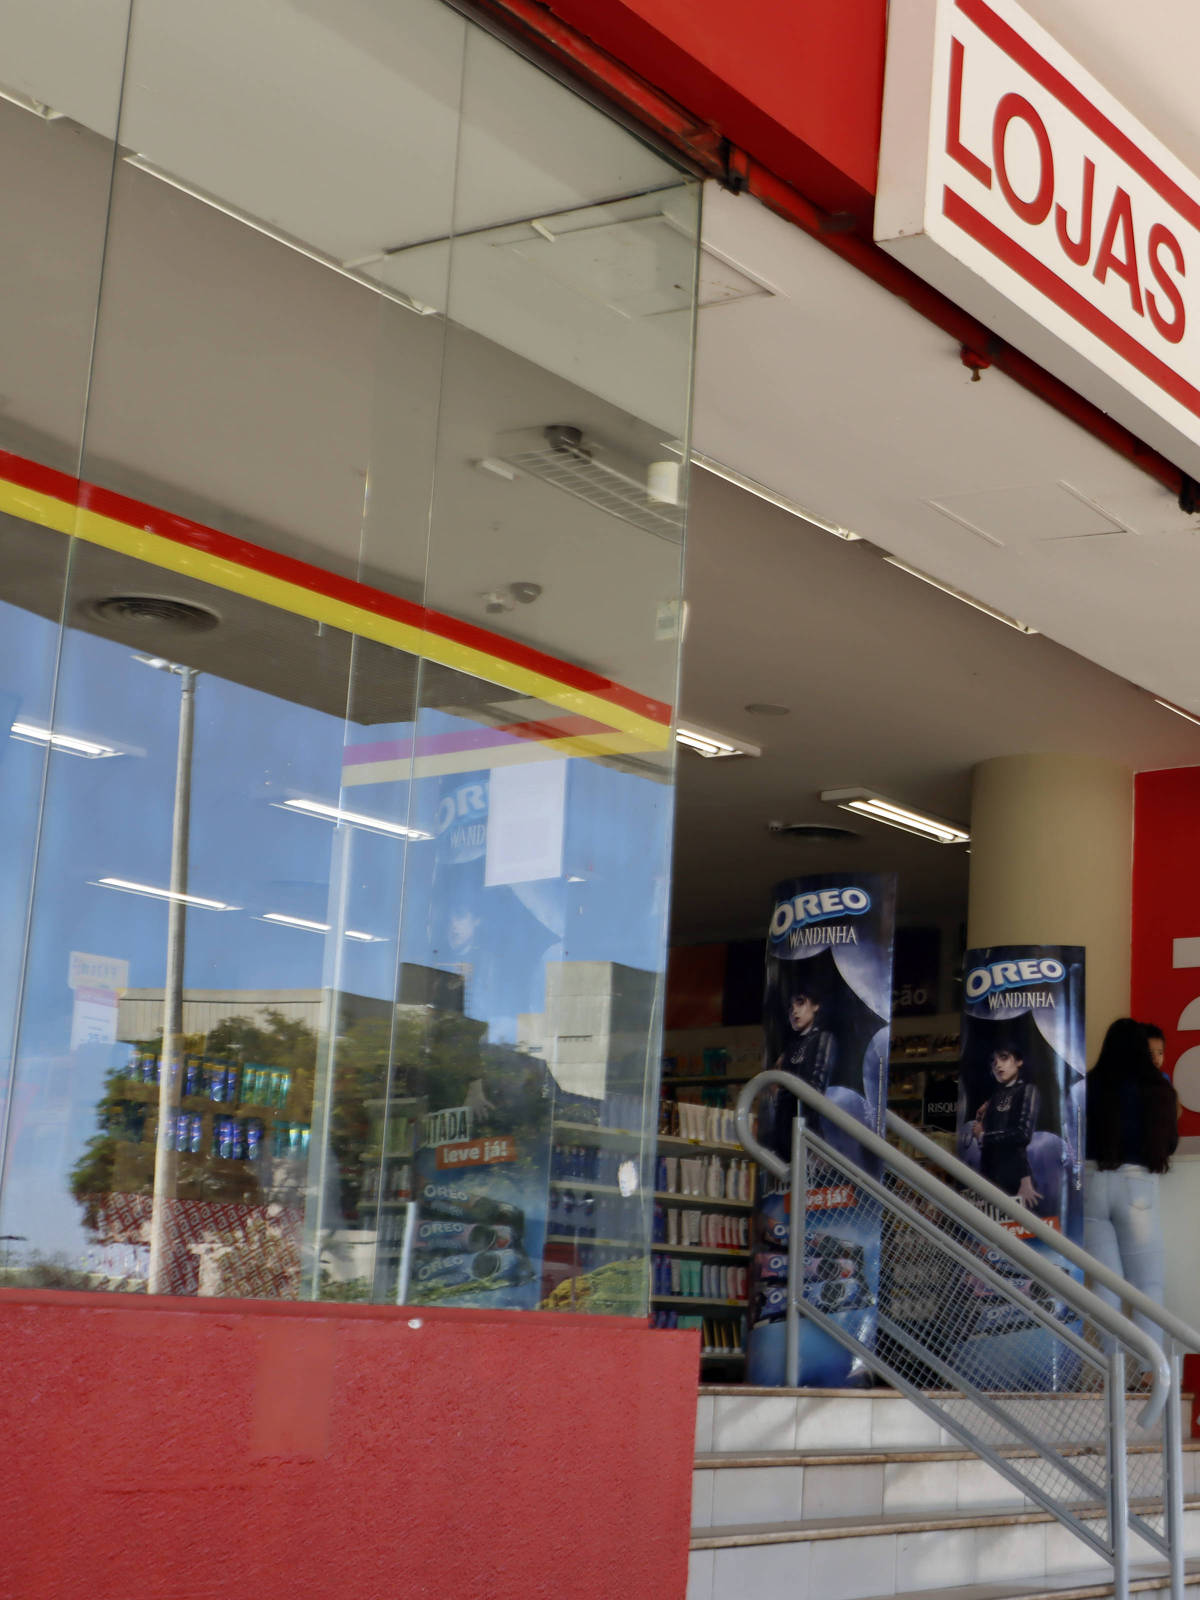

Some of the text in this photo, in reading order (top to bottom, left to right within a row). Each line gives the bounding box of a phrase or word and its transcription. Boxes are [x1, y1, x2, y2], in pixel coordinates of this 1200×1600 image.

[945, 35, 1187, 344] LOJAS
[434, 783, 489, 836] OR
[451, 825, 487, 848] WAND
[769, 889, 868, 937] OREO
[789, 925, 859, 950] WANDINHA
[966, 959, 1064, 998] OREO
[987, 991, 1056, 1010] WANDINHA
[928, 1102, 958, 1114] RISQU
[443, 1141, 508, 1163] leve já!
